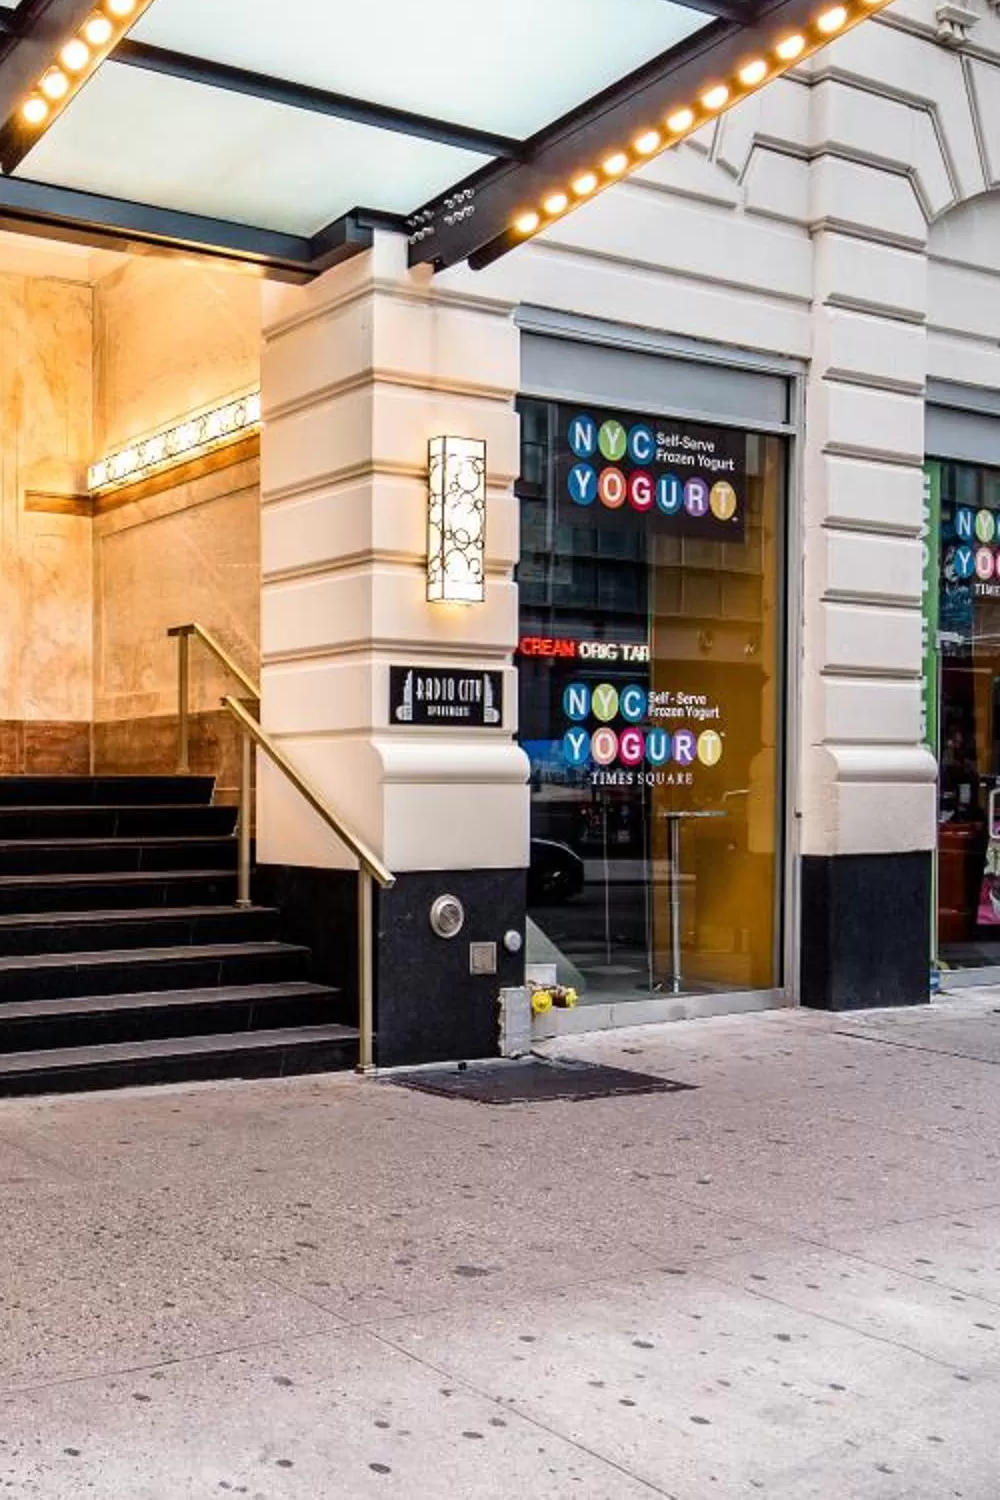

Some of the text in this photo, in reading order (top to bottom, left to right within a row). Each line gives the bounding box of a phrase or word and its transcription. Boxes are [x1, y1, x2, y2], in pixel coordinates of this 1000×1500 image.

[573, 419, 715, 461] NYC Self-Serve
[656, 448, 735, 472] Frozen Yogurt
[572, 468, 732, 518] YOGURT
[520, 637, 576, 657] CREAM
[415, 677, 482, 702] RADIO CITY
[567, 688, 643, 717] NYC
[648, 704, 721, 721] Frozen Yogurt
[567, 733, 720, 762] YOGURT
[591, 771, 694, 787] TIMES SQUARE
